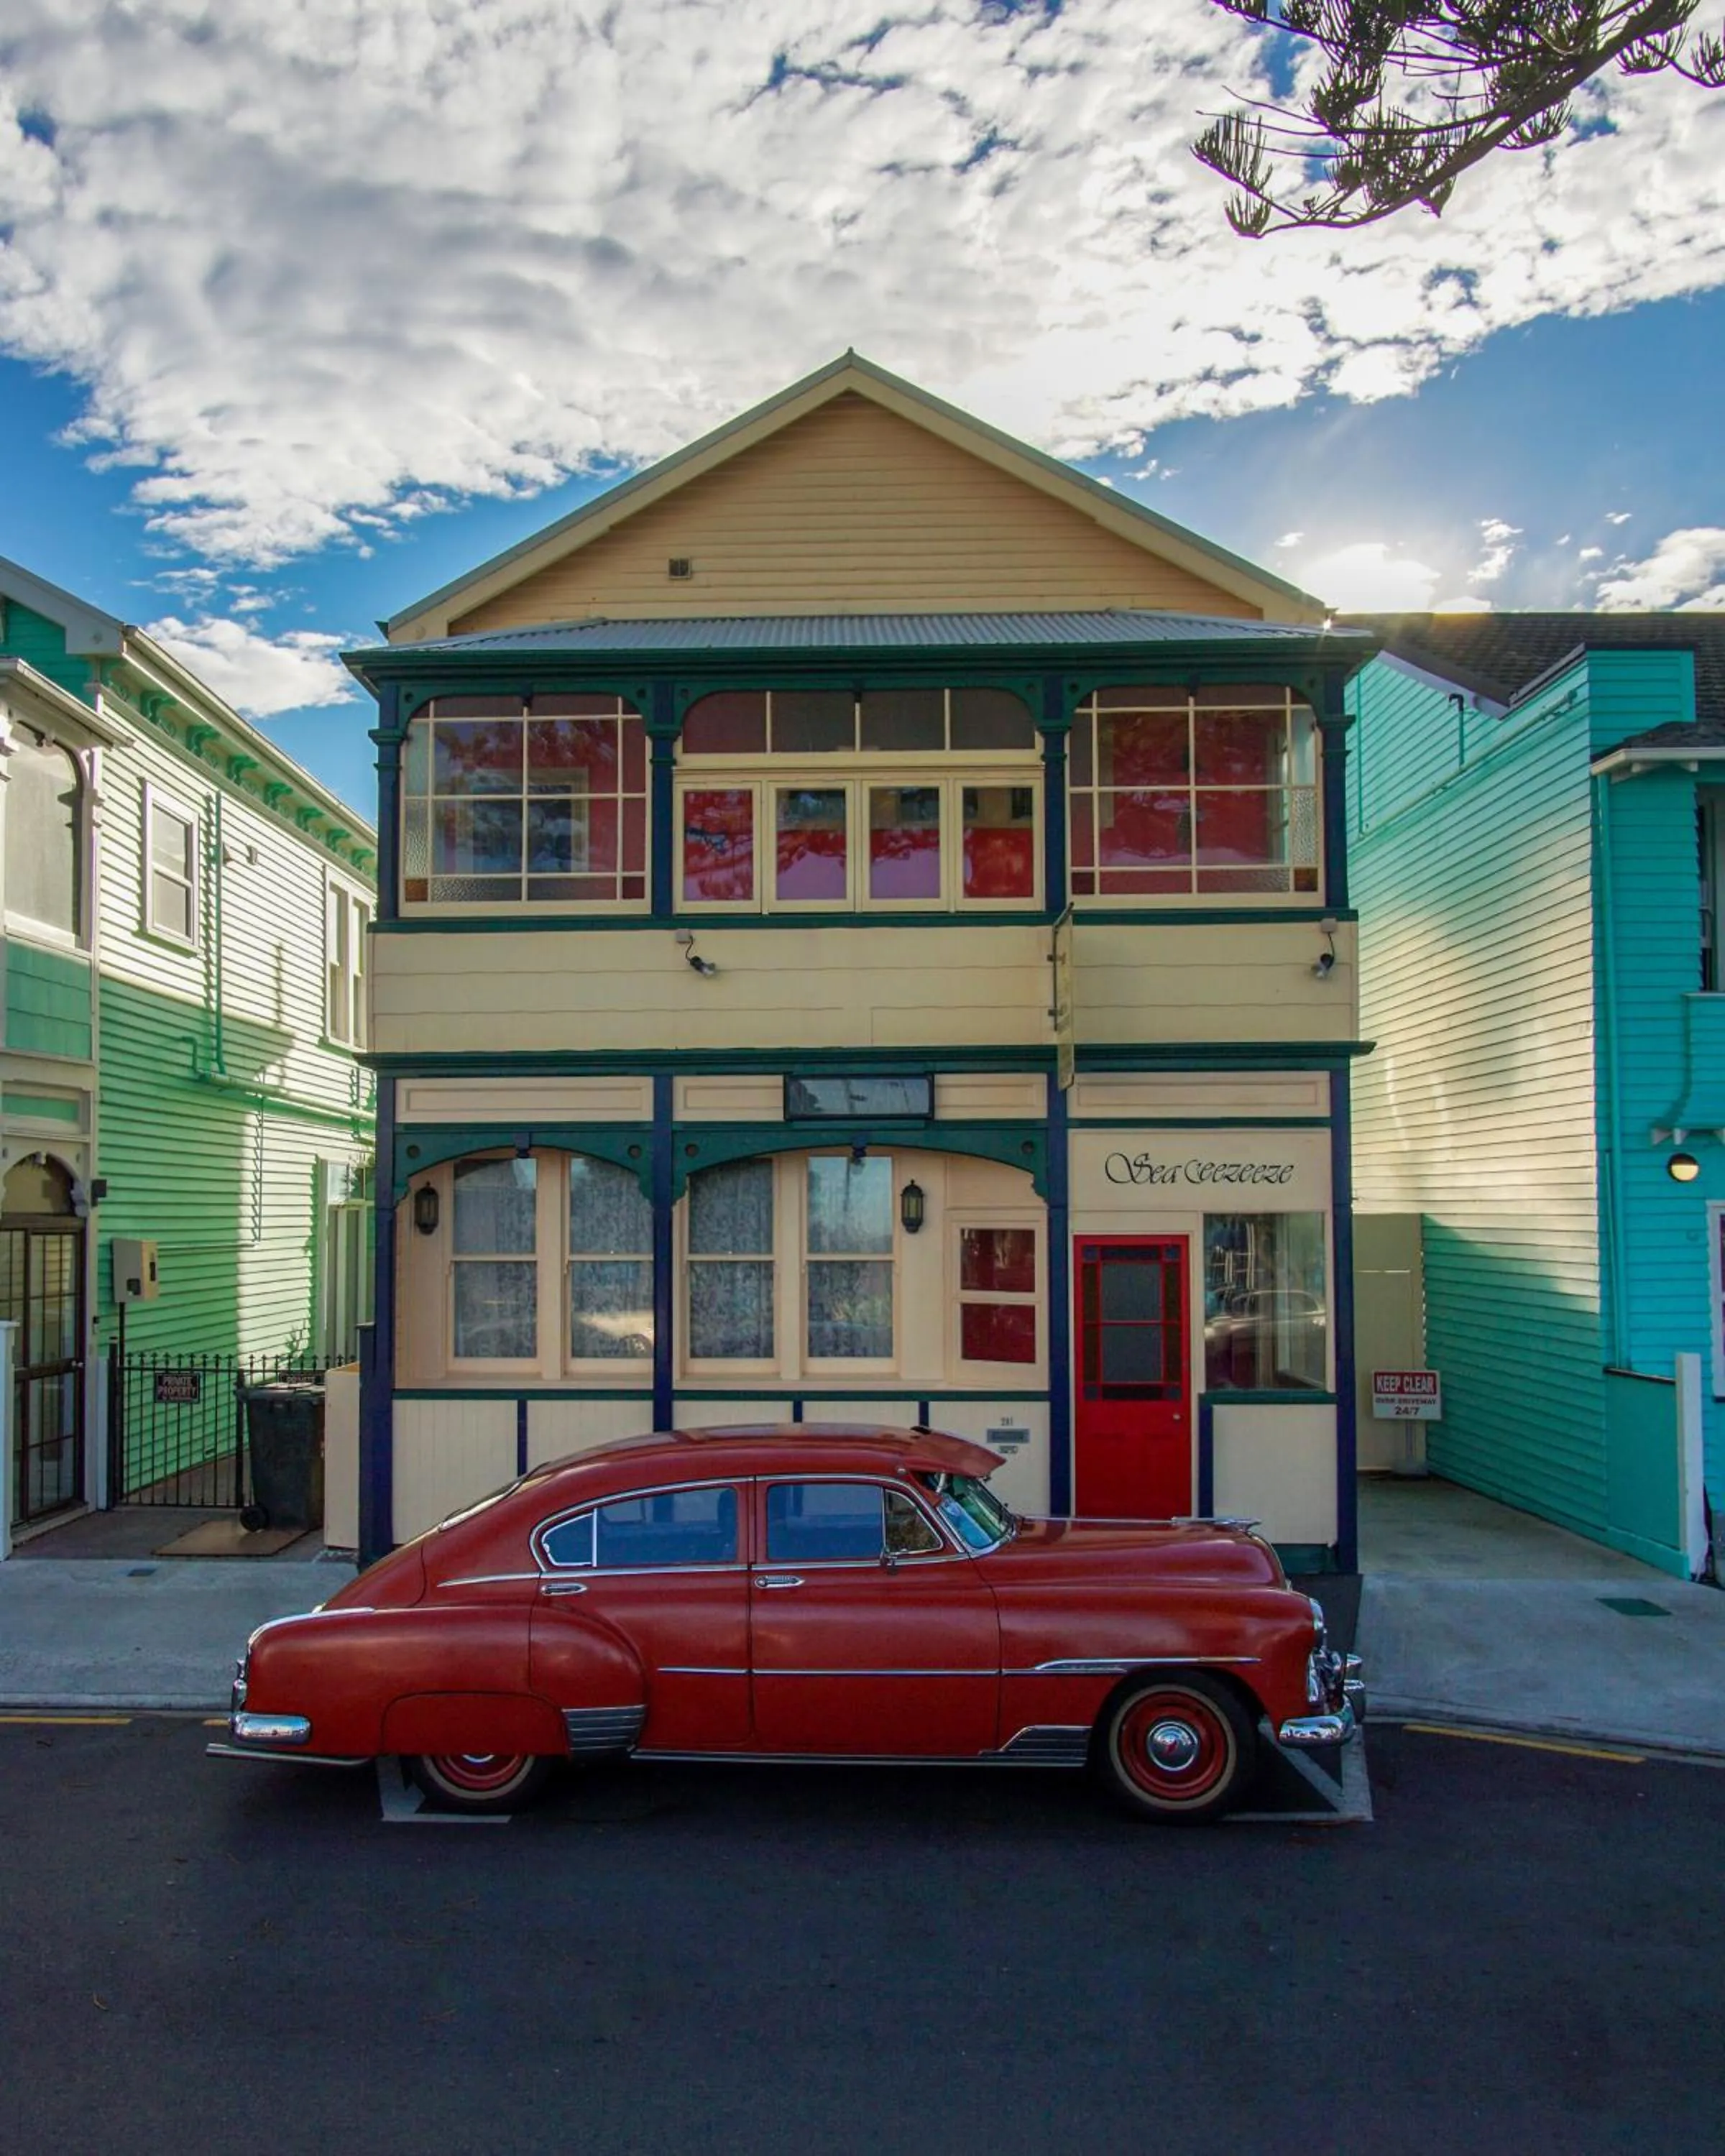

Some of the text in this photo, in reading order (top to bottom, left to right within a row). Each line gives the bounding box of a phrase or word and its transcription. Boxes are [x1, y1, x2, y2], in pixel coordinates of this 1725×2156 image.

[1105, 1152, 1182, 1184] Sea
[1376, 1375, 1435, 1393] KEEP CLEAR
[1394, 1406, 1420, 1416] 24/7
